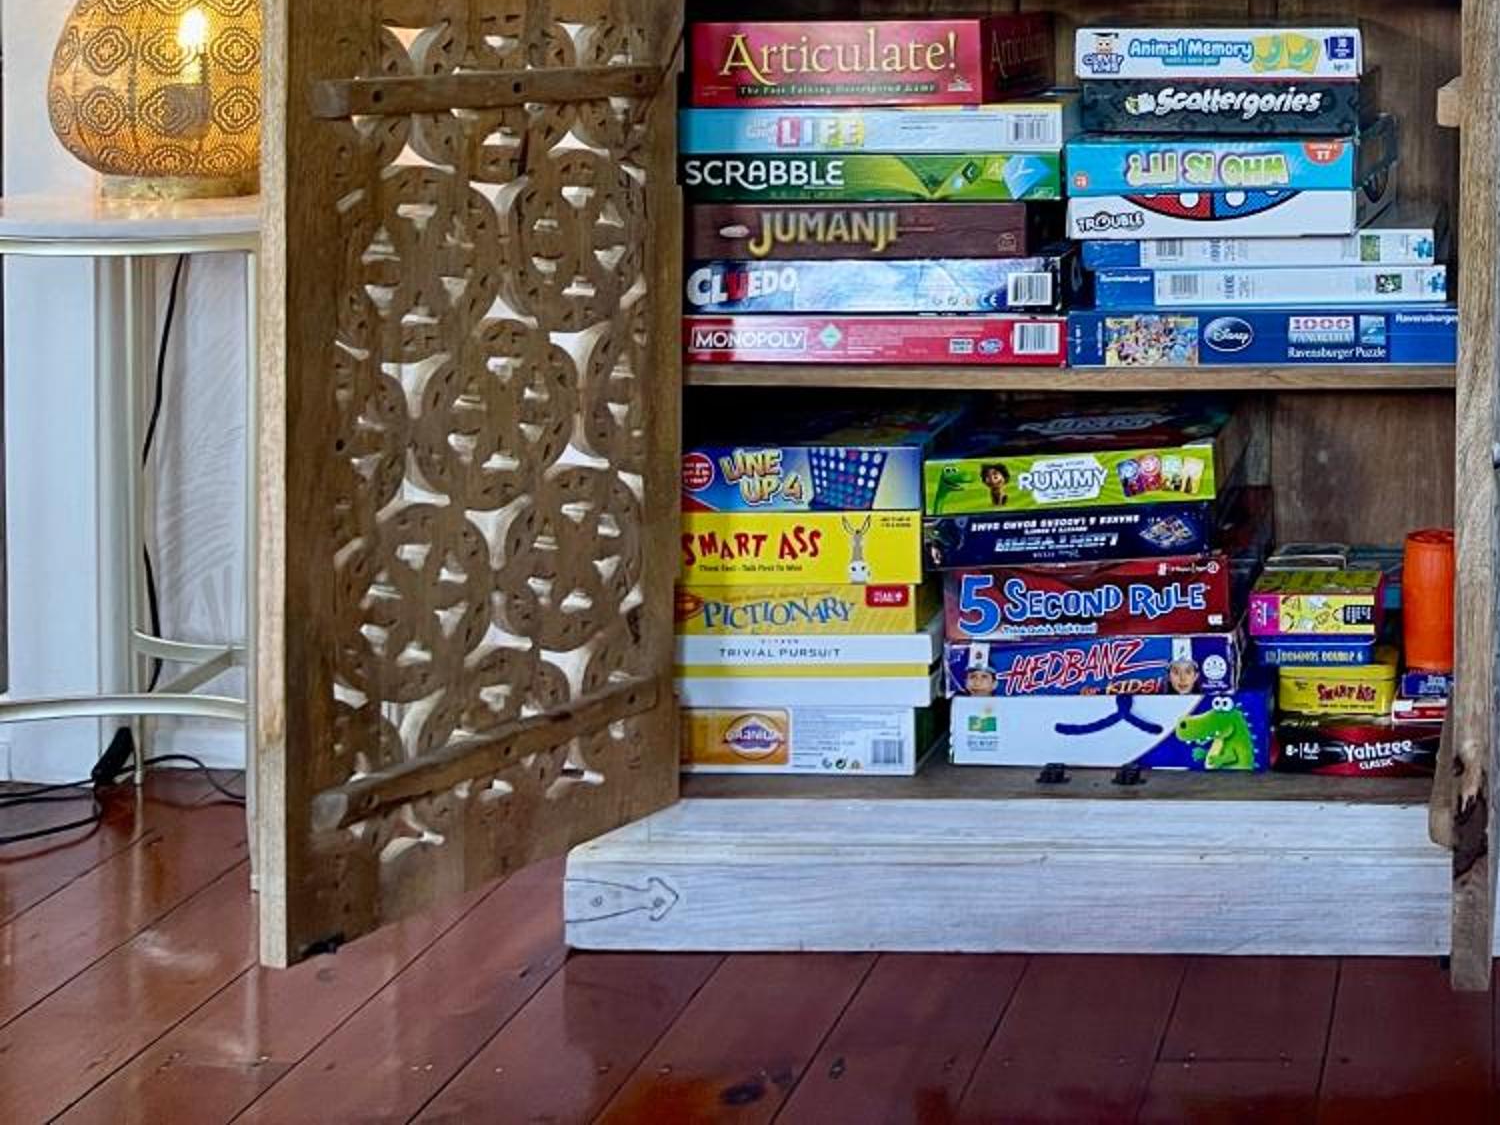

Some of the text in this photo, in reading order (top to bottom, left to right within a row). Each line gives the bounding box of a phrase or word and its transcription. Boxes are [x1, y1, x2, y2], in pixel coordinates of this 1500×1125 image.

[719, 29, 958, 86] Articulate!
[1128, 38, 1184, 57] Animal
[1186, 38, 1255, 63] Memory
[1153, 86, 1323, 120] Scattergories
[778, 117, 865, 147] LIFE
[684, 160, 845, 192] SCRABBLE
[1126, 151, 1289, 187] WHO IS IT?
[748, 210, 899, 258] JUMANJI
[1076, 211, 1145, 233] TROUBLE
[686, 267, 800, 306] CLUEDO
[694, 329, 804, 349] MONOPOLY
[1210, 326, 1250, 345] Disney
[1293, 318, 1351, 331] 1000
[1287, 347, 1387, 360] Ravensburger Puzzle
[718, 447, 783, 484] LINE
[1017, 466, 1109, 491] RUMMY
[739, 473, 805, 506] UP 4
[681, 524, 822, 567] SMART ASS
[703, 595, 857, 628] PICTIONARY
[957, 574, 1207, 635] 5 SECOND RULE
[719, 648, 841, 658] TRIVIAL PURSUIT
[997, 638, 1146, 694] HEDBANZ
[1105, 677, 1162, 695] KIDS!
[1343, 739, 1413, 764] Yahtzee
